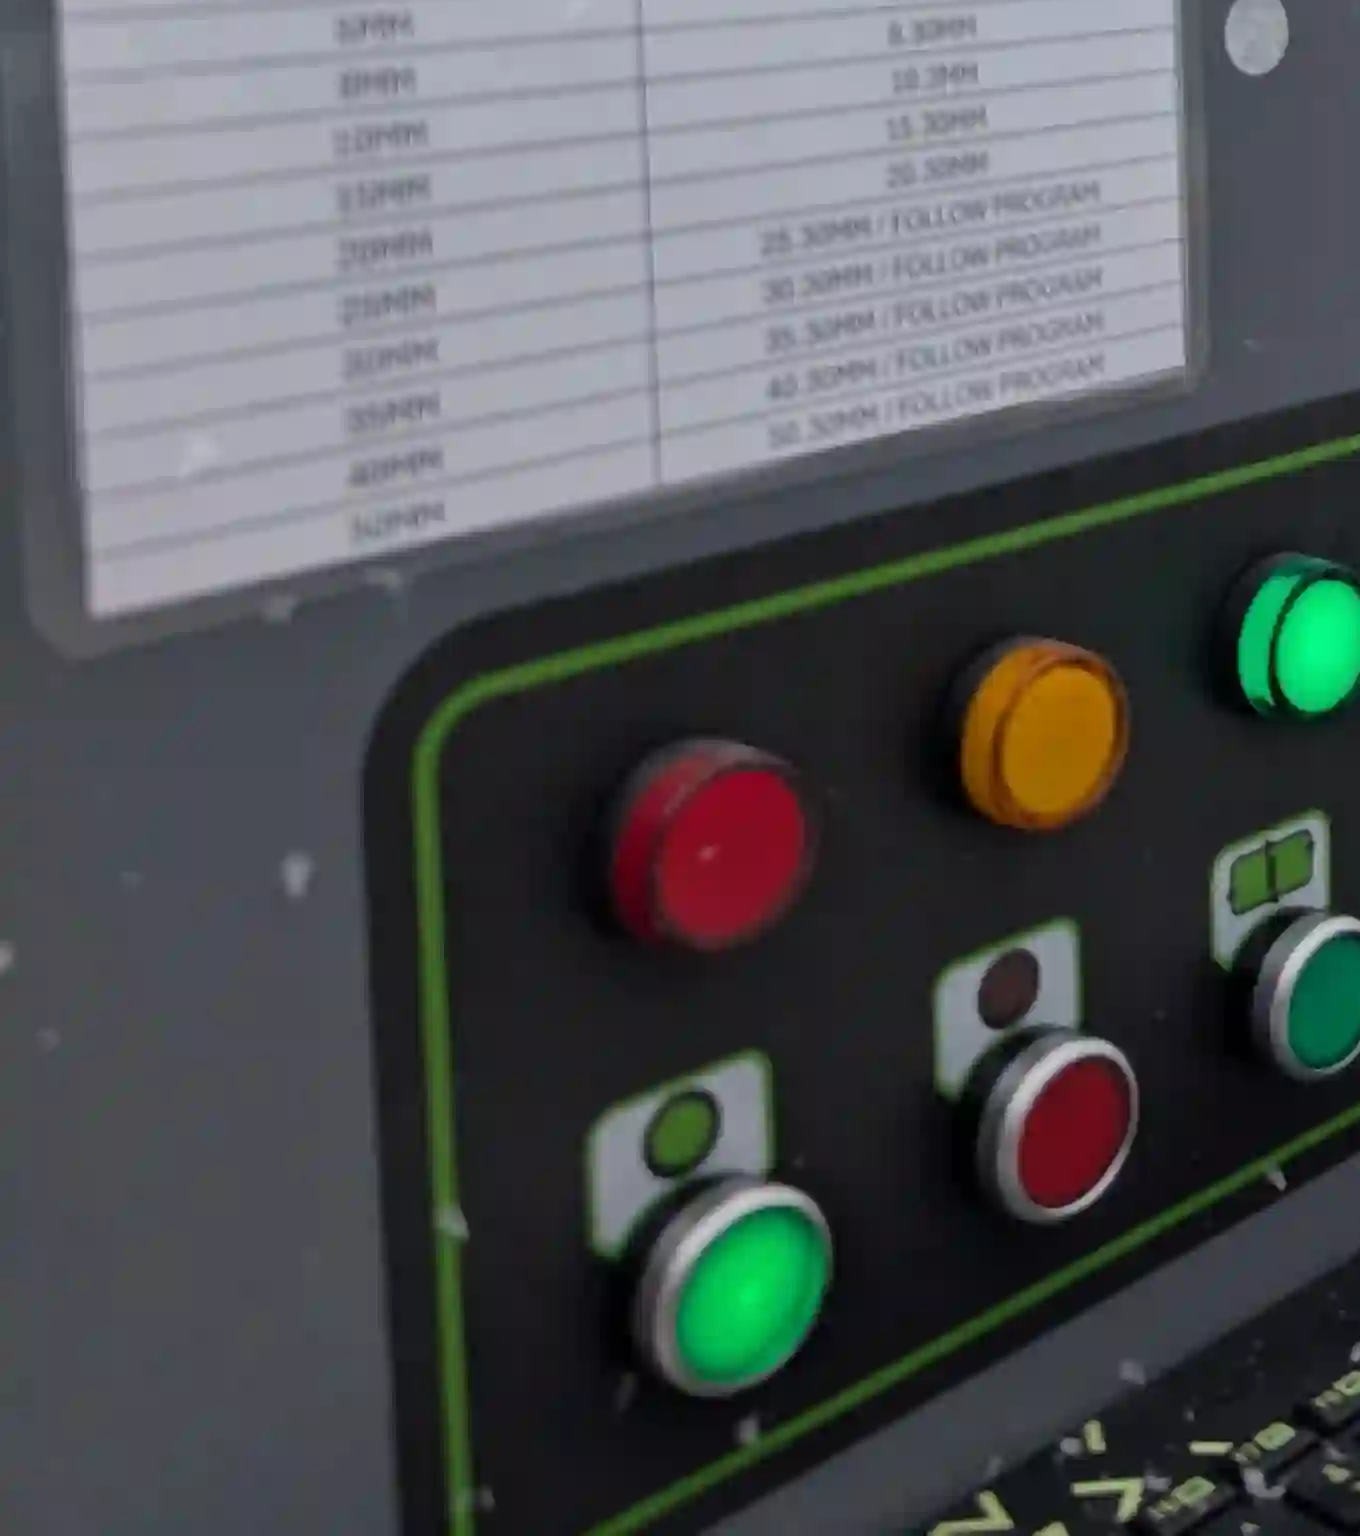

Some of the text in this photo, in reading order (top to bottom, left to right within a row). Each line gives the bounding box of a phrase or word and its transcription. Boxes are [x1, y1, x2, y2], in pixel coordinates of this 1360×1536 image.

[891, 198, 989, 236] FOLLOW
[993, 179, 1100, 213] PROGRAM
[896, 244, 989, 280] FOLLOW
[996, 223, 1101, 259] PROGRAM
[899, 291, 990, 328] FOLLOW
[997, 267, 1103, 305] PROGRAM
[899, 335, 993, 373] FOLLOW
[998, 310, 1104, 349] PROGRAM
[900, 380, 993, 417] FOLLOW
[999, 353, 1105, 393] PROGRAM
